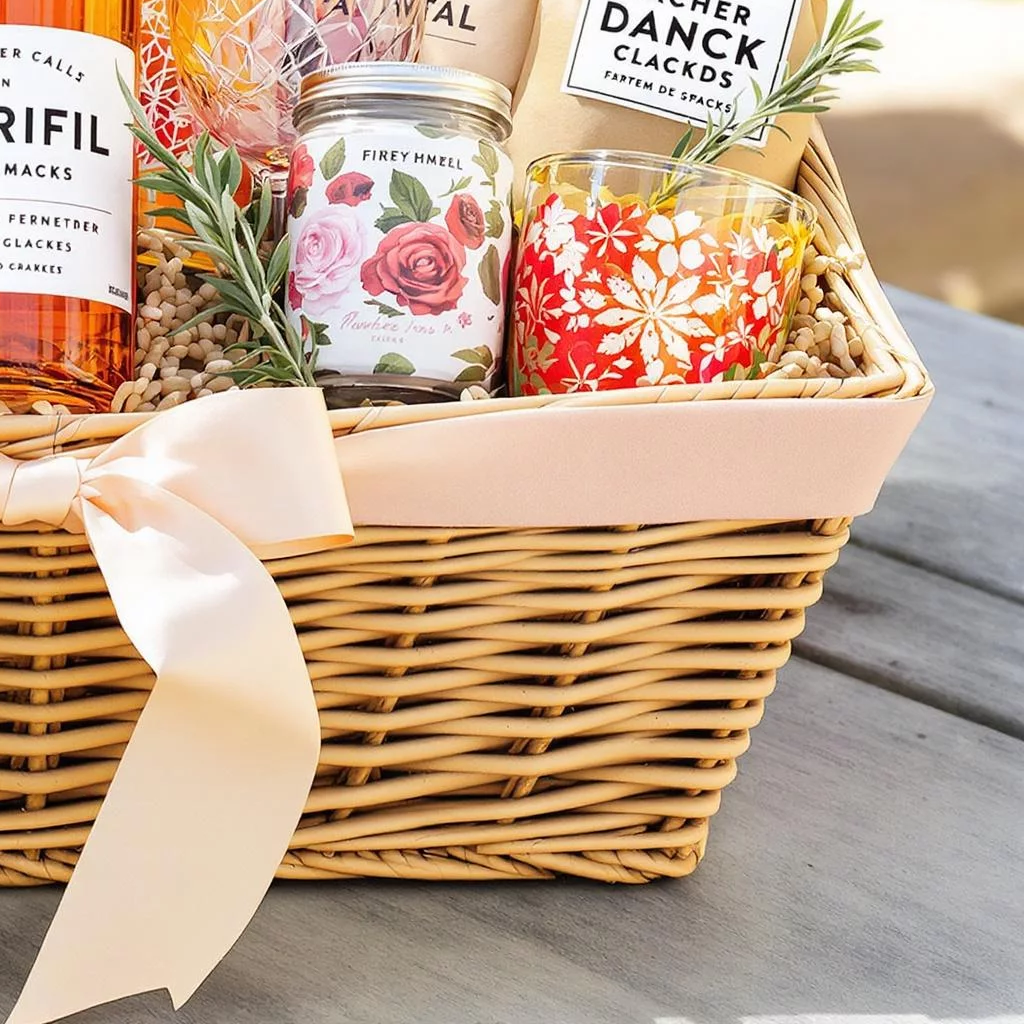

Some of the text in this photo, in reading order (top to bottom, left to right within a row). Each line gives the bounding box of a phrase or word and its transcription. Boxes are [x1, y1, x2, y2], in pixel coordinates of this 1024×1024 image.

[600, 1, 766, 70] DANCK
[31, 51, 85, 83] CALLS
[614, 45, 733, 89] CLACKDS
[658, 85, 676, 97] DE
[4, 163, 73, 180] MACKS
